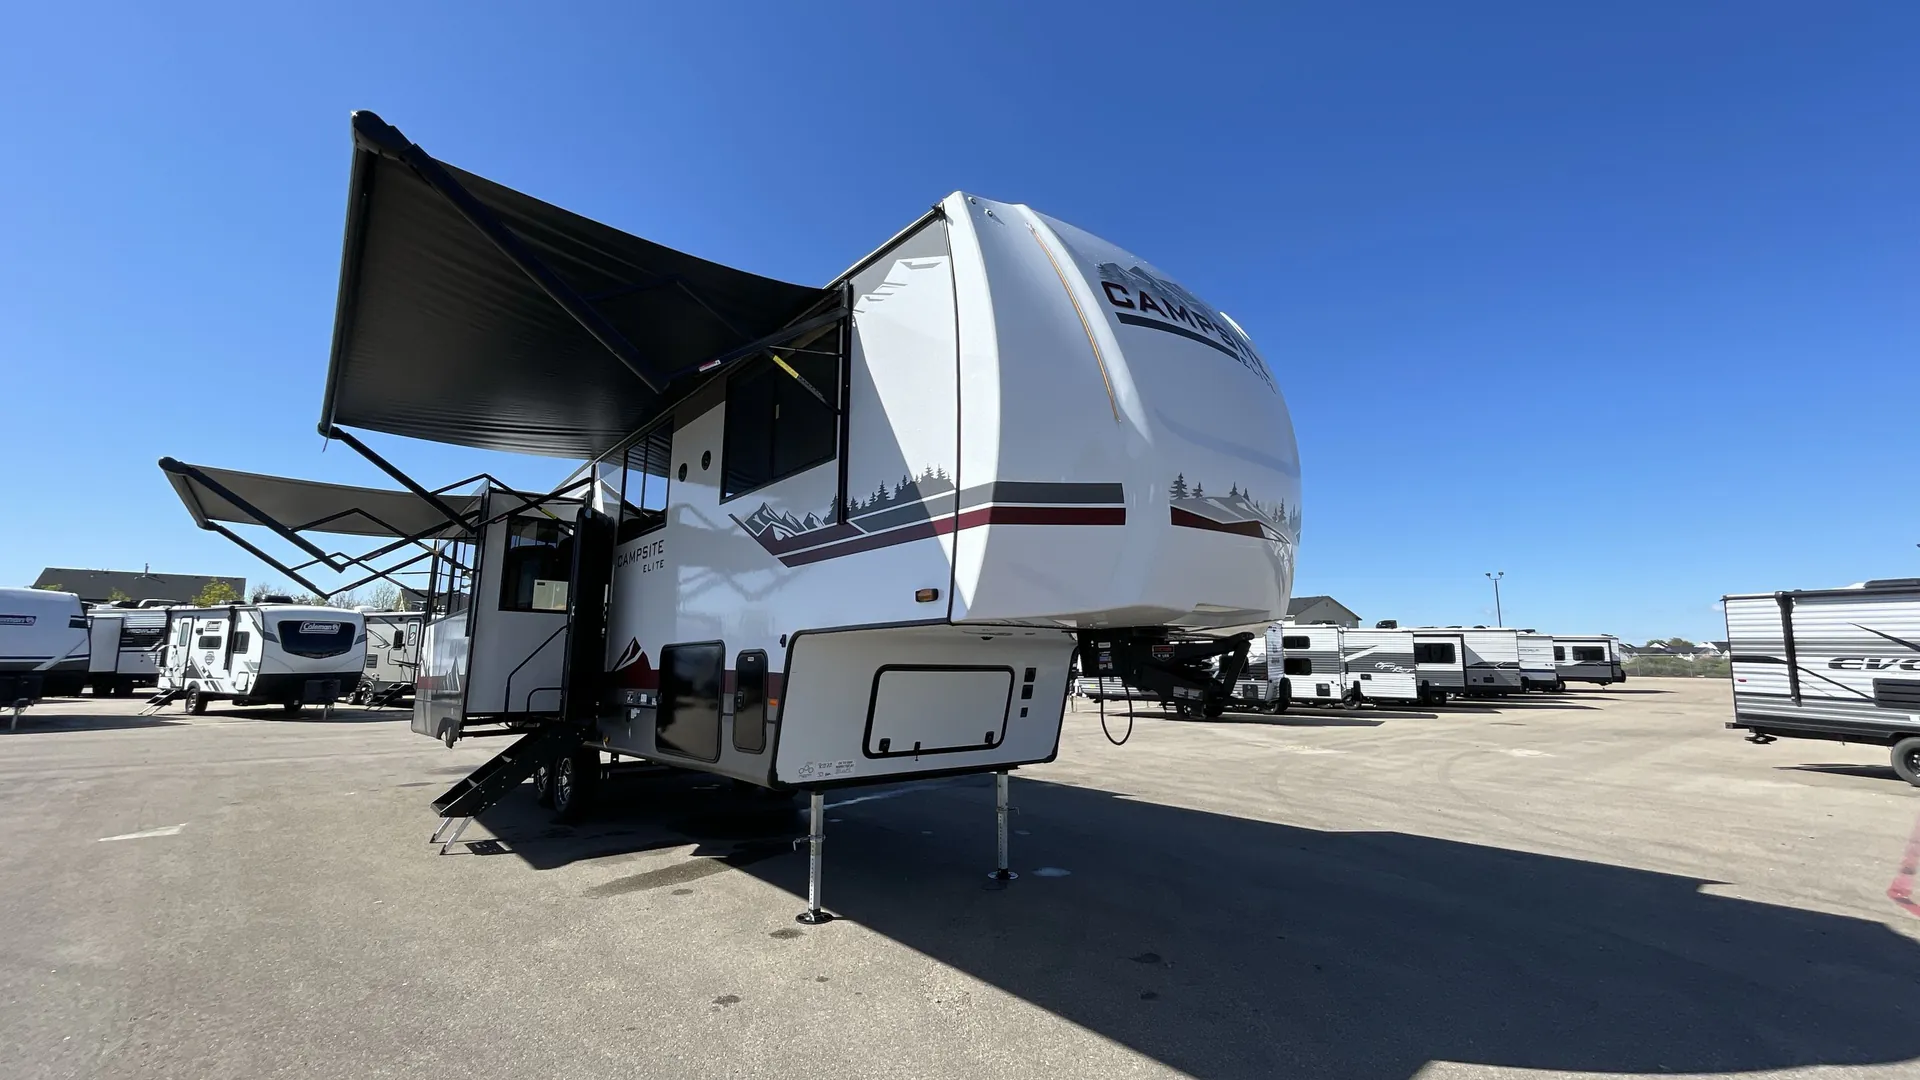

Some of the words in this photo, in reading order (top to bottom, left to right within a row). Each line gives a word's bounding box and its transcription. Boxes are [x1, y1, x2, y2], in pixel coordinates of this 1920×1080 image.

[1101, 281, 1270, 381] CAMPSITE
[617, 539, 665, 568] CAMPSITE
[643, 559, 665, 573] ELITE
[303, 622, 332, 630] Coleman
